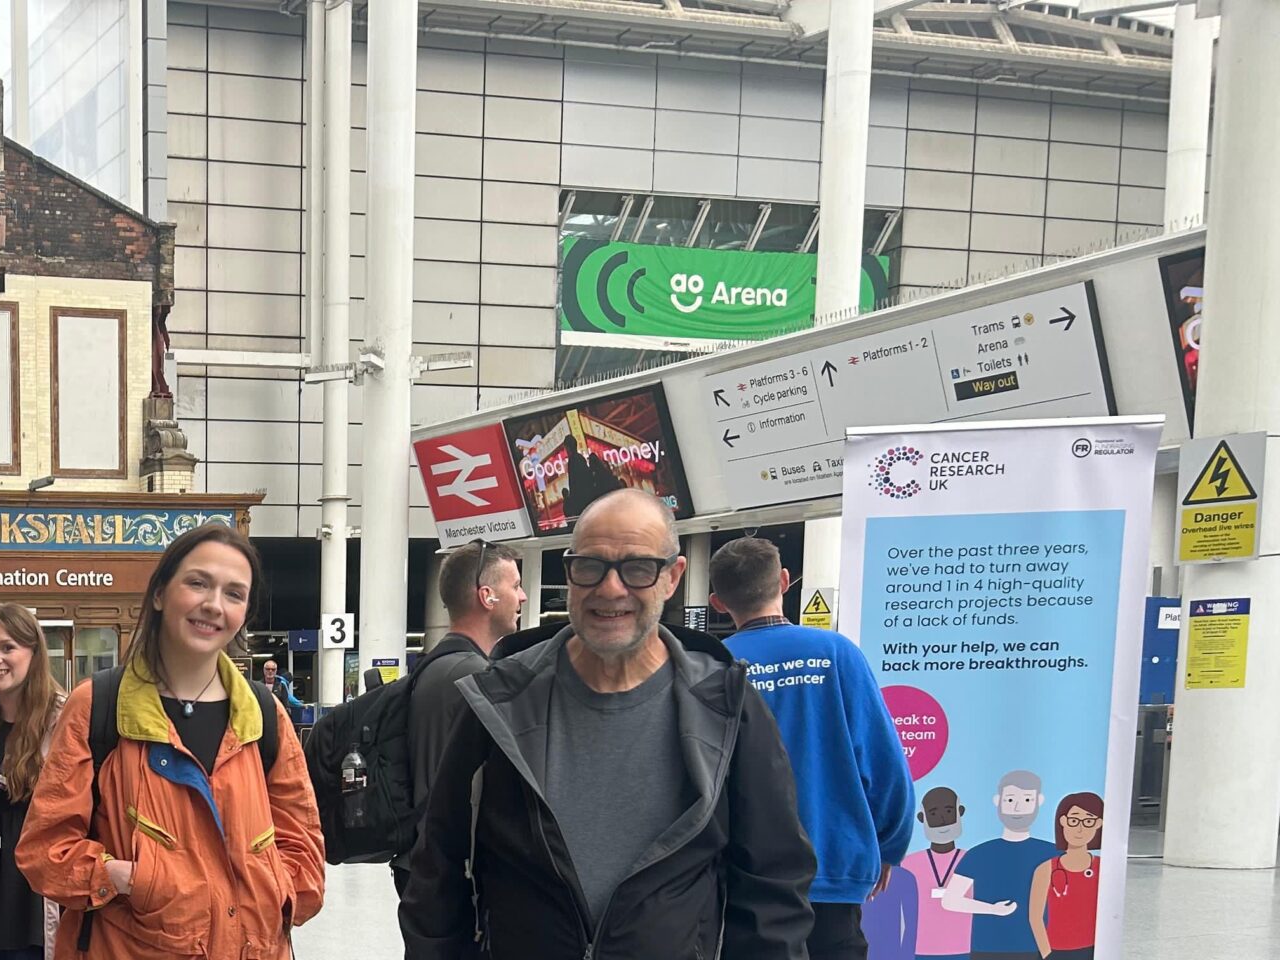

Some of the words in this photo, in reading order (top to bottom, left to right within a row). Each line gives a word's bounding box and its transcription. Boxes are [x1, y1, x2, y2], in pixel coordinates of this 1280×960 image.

[670, 272, 704, 294] ao
[710, 281, 788, 307] Arena
[971, 319, 1005, 336] Trams
[862, 344, 908, 362] Platforms
[908, 340, 913, 351] 1
[920, 336, 928, 348] 2
[977, 338, 1008, 354] Arena
[977, 356, 1012, 373] Toilets
[749, 371, 788, 388] Platforms
[789, 369, 795, 379] 3
[801, 366, 808, 376] 6
[972, 379, 995, 394] Way
[997, 374, 1017, 388] out
[753, 391, 776, 406] Cycle
[776, 385, 808, 400] parking
[759, 412, 806, 429] Information
[1075, 444, 1089, 452] FR
[522, 456, 566, 480] Good
[602, 439, 665, 465] money.
[929, 451, 989, 464] CANCER
[781, 463, 806, 476] Buses
[929, 464, 1005, 478] RESEARCH
[929, 479, 949, 491] UK
[1194, 511, 1244, 523] Danger
[444, 522, 487, 539] Manchester
[486, 519, 517, 534] Victoria
[1181, 525, 1217, 535] Overhead
[1218, 524, 1232, 532] live
[1234, 522, 1255, 530] wires
[887, 547, 924, 559] Over
[928, 546, 954, 558] the
[957, 545, 993, 560] past
[997, 544, 1039, 556] three
[1043, 543, 1089, 557] years,
[886, 563, 930, 576] we've
[934, 562, 965, 575] had
[969, 563, 985, 574] to
[989, 562, 1021, 574] turn
[1025, 561, 1069, 576] away
[55, 568, 113, 587] Centre
[885, 580, 942, 594] around
[946, 580, 951, 592] 1
[955, 579, 969, 592] in
[973, 579, 983, 591] 4
[987, 576, 1085, 594] high-quality
[885, 597, 953, 610] research
[957, 596, 1022, 612] projects
[1026, 594, 1093, 607] because
[884, 615, 899, 628] of
[902, 618, 913, 627] a
[917, 614, 948, 627] lack
[952, 613, 968, 626] of
[971, 612, 1019, 625] funds.
[329, 617, 346, 644] 3
[882, 642, 918, 655] With
[921, 642, 958, 658] your
[960, 640, 999, 656] help,
[1002, 641, 1026, 652] we
[1029, 640, 1059, 651] can
[782, 659, 805, 670] we
[806, 657, 832, 668] are
[881, 660, 920, 672] back
[923, 660, 965, 671] more
[968, 656, 1089, 672] breakthroughs.
[776, 673, 826, 687] cancer
[892, 714, 920, 726] eak
[922, 715, 936, 725] to
[902, 730, 936, 740] team
